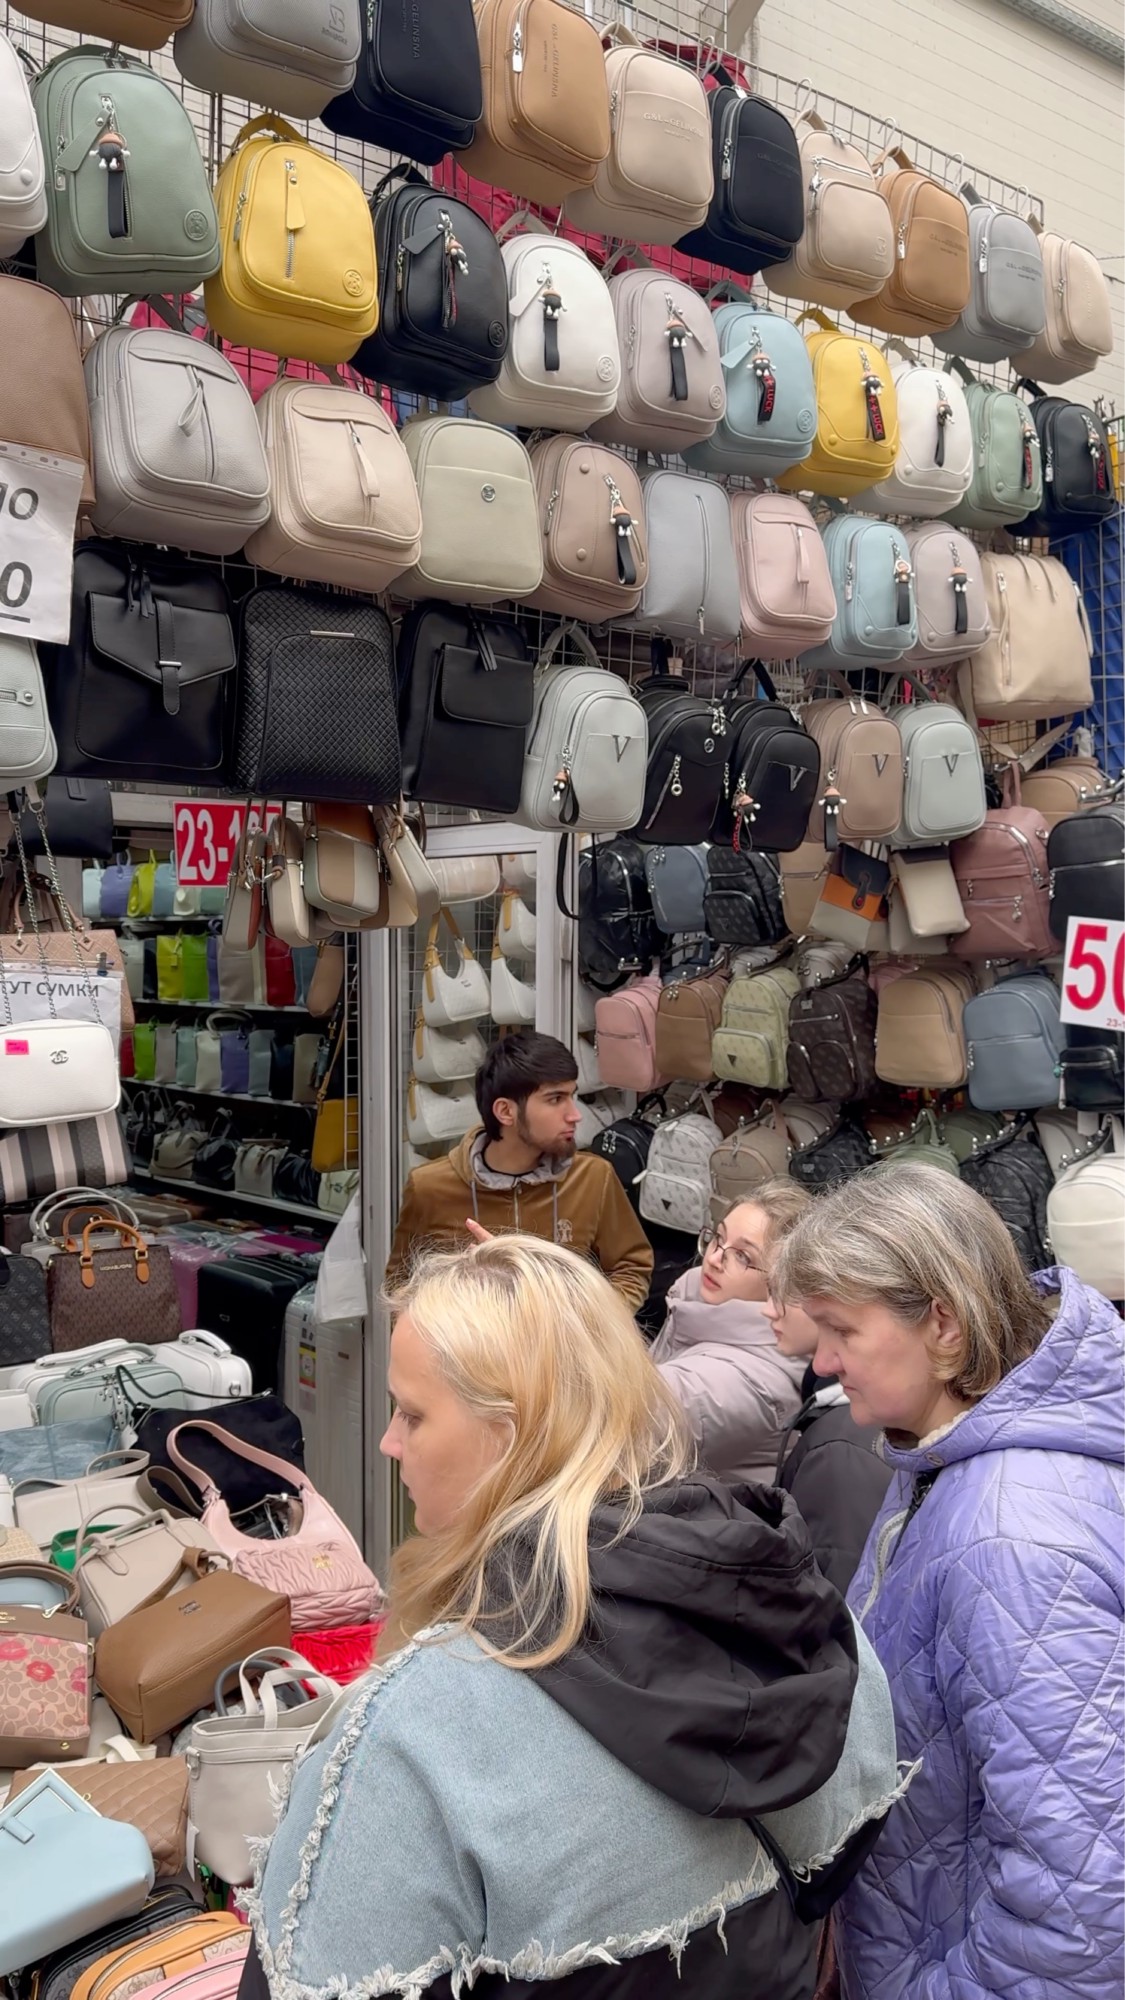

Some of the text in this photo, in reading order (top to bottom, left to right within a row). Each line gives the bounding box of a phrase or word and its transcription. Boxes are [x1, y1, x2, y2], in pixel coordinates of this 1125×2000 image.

[764, 388, 775, 413] LUCK
[0, 481, 39, 520] О
[1065, 923, 1125, 1012] 5
[36, 981, 99, 997] СУМКИ
